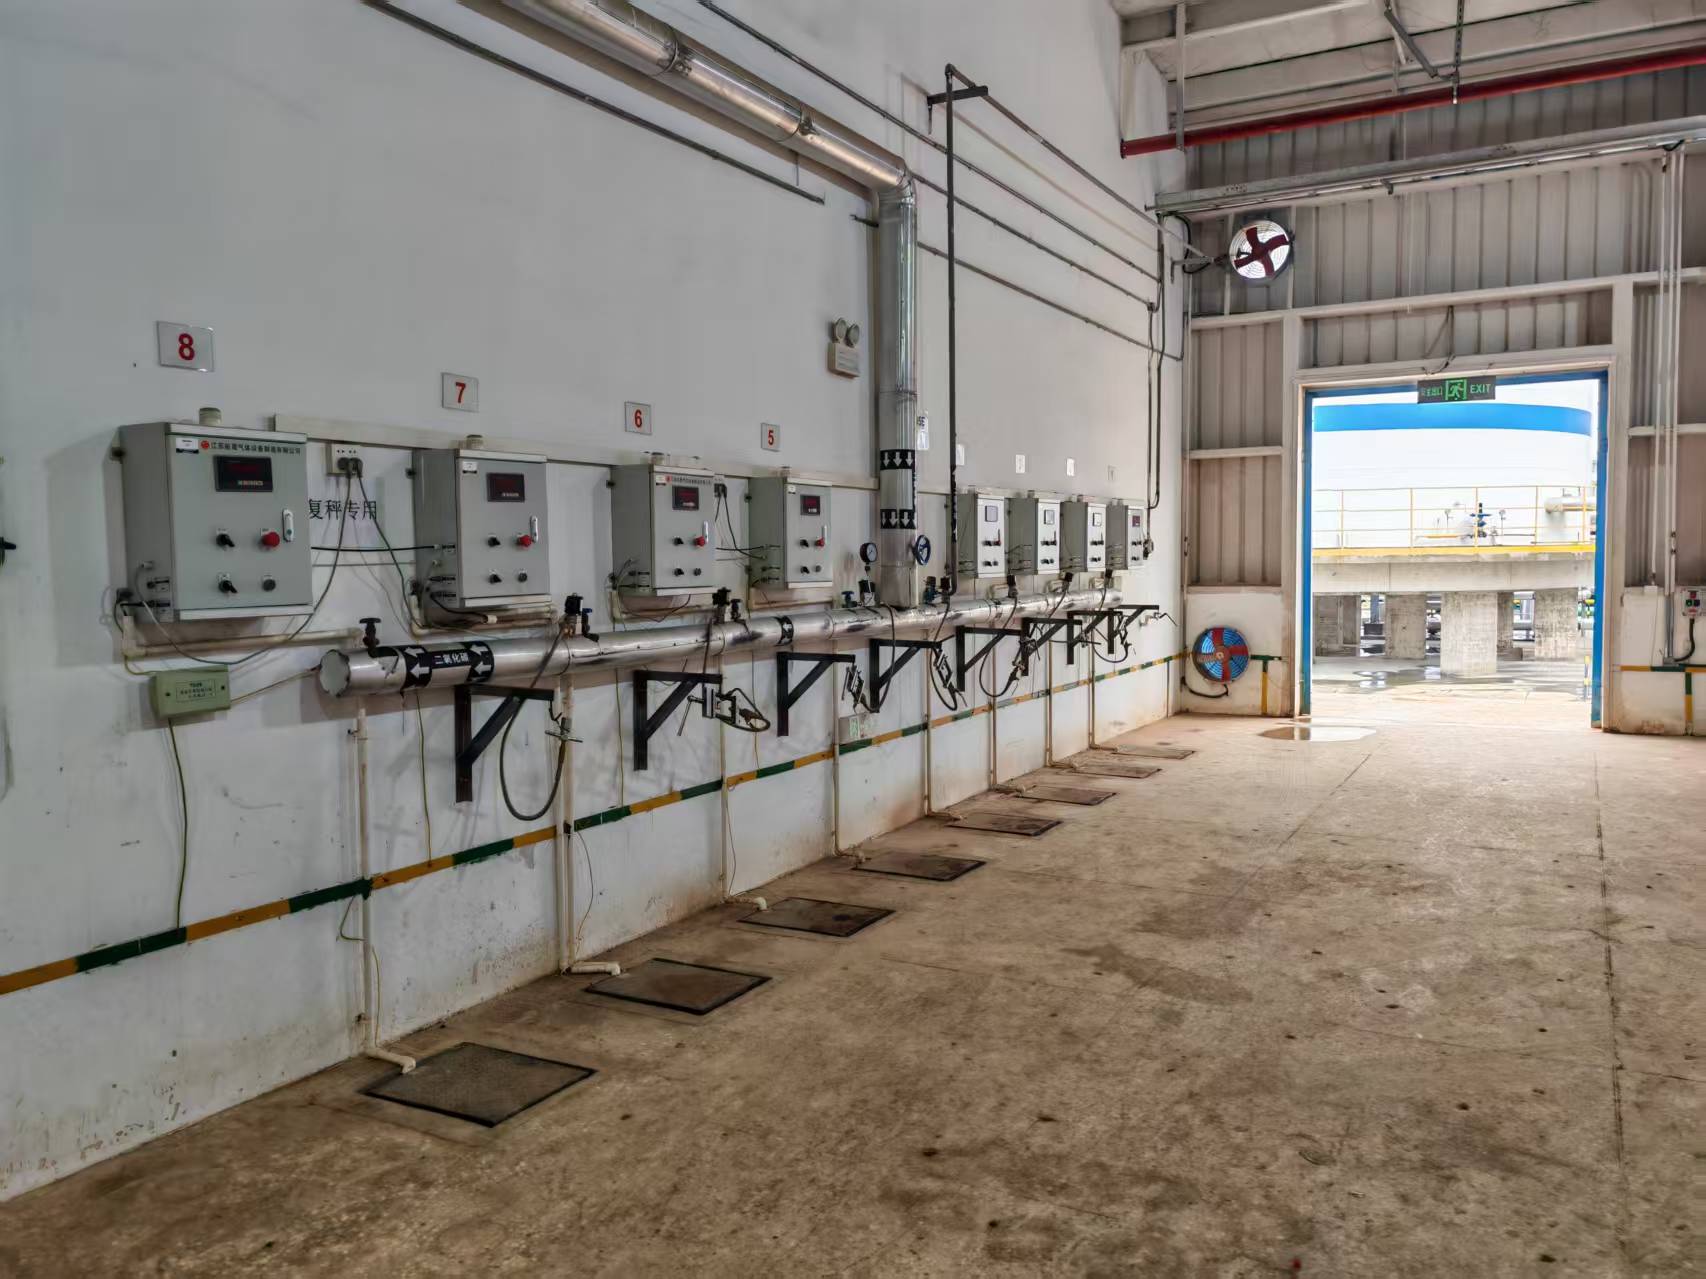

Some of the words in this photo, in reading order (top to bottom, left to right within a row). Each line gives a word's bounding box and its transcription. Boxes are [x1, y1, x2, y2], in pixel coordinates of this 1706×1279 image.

[178, 333, 195, 361] 8
[455, 381, 466, 404] 7
[1470, 384, 1492, 395] EXIT
[634, 409, 643, 428] 6
[768, 429, 775, 446] 5
